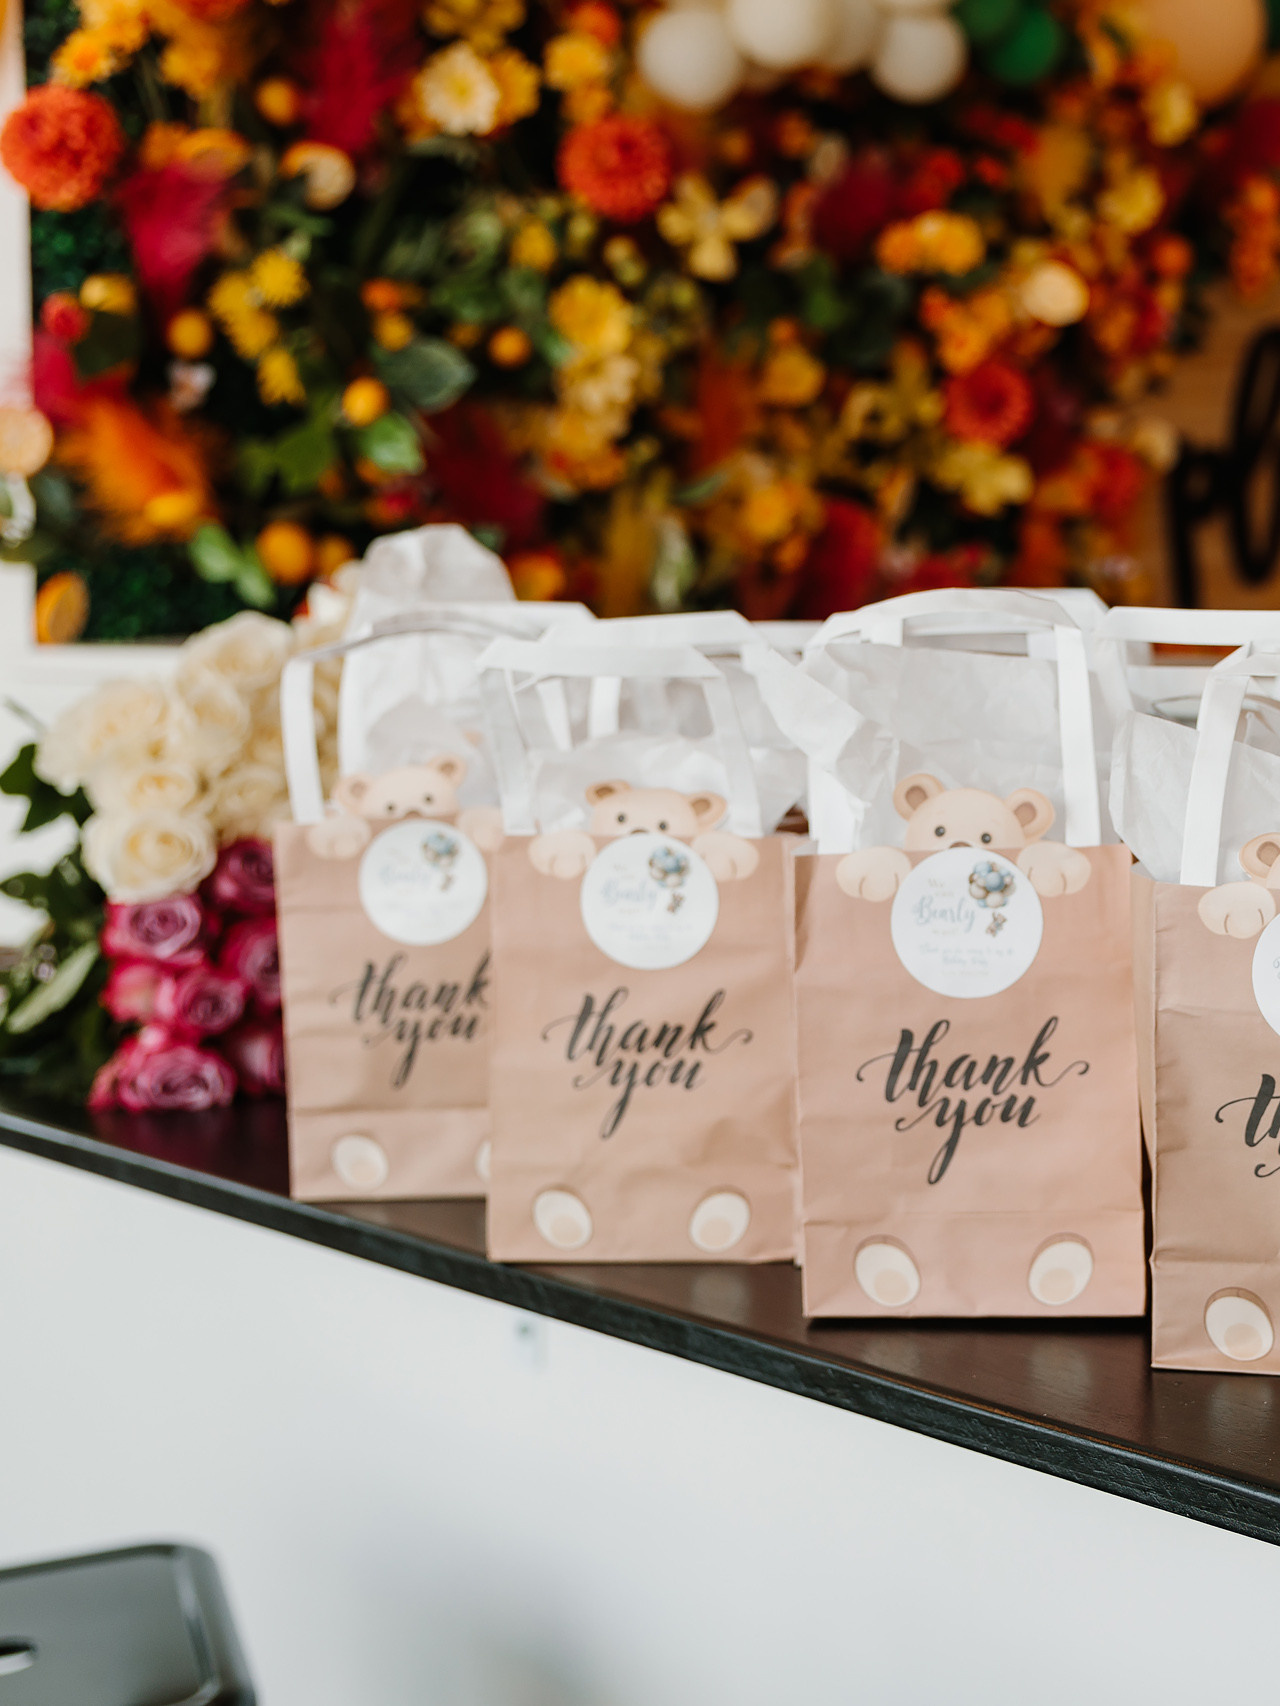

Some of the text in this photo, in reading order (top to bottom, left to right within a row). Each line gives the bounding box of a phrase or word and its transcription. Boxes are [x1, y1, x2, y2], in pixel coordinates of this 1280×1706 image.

[361, 1014, 479, 1091] you
[541, 986, 753, 1067] thank
[857, 1016, 1089, 1107] thank
[572, 1058, 706, 1141] you
[895, 1094, 1040, 1184] you
